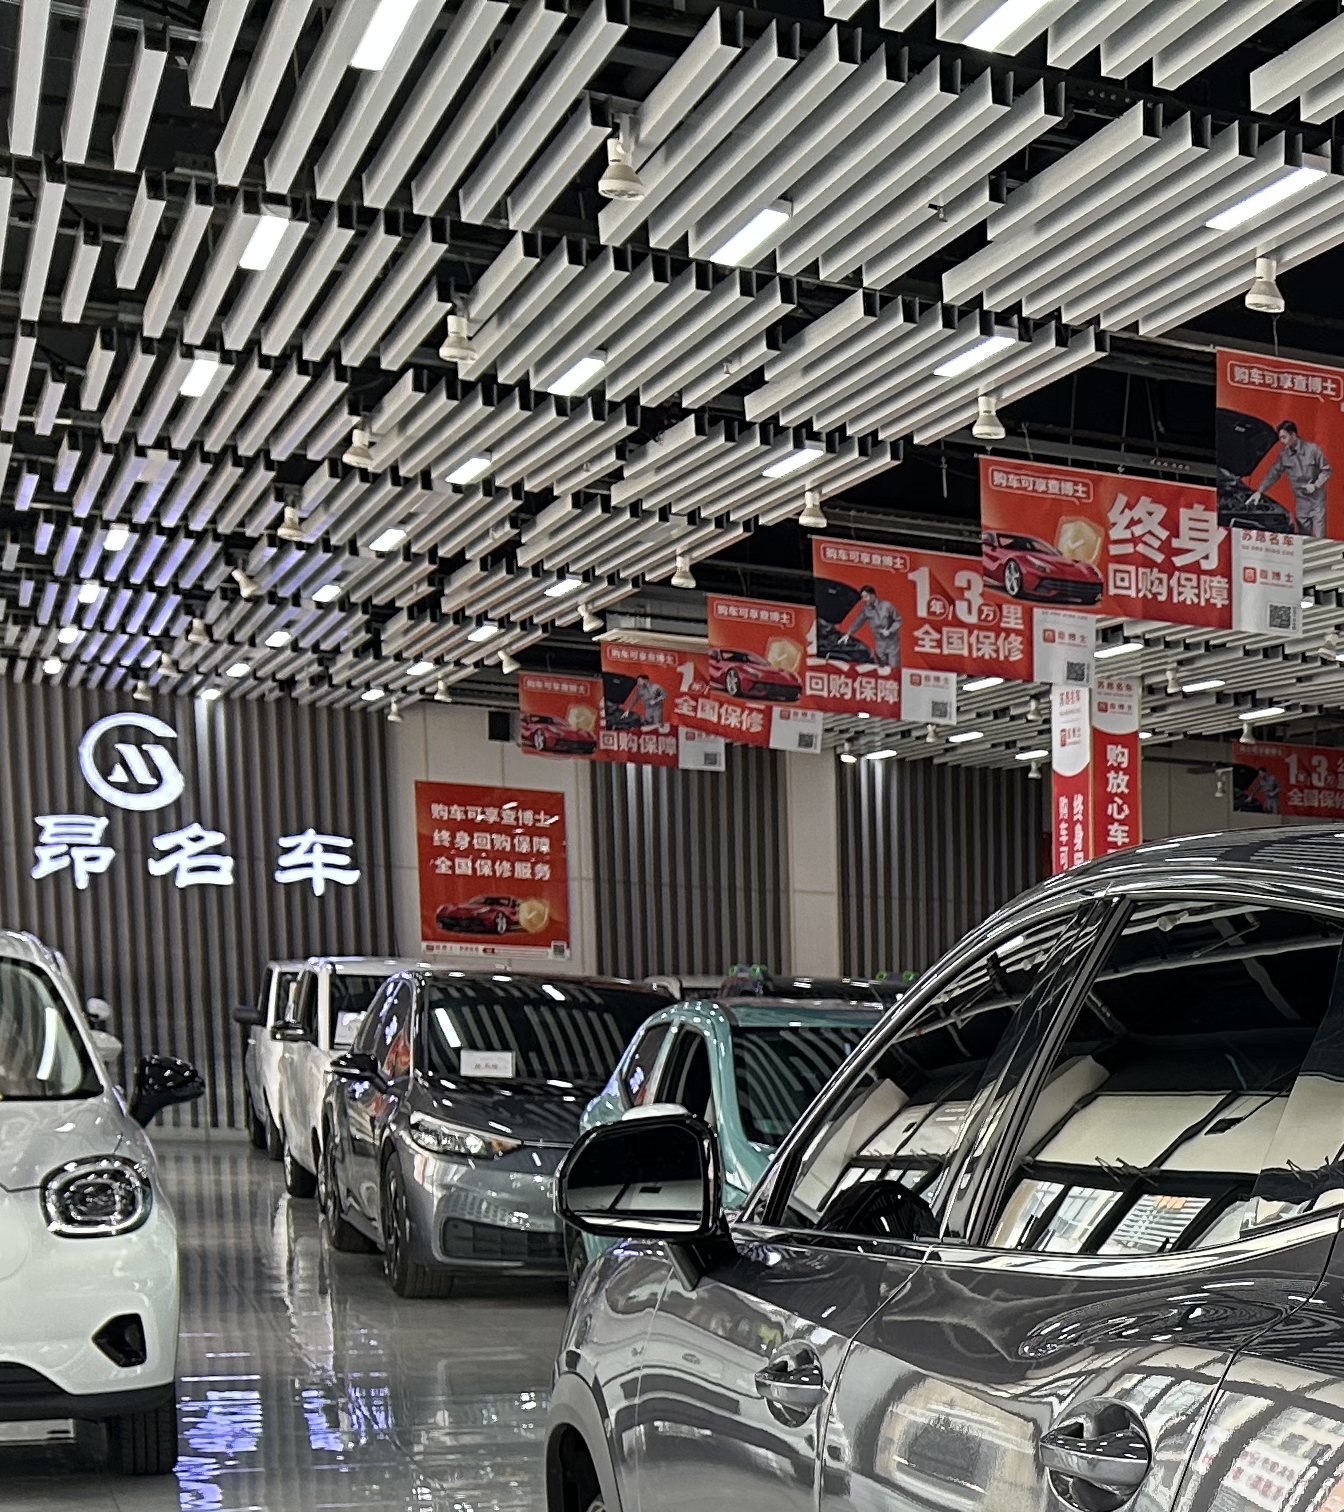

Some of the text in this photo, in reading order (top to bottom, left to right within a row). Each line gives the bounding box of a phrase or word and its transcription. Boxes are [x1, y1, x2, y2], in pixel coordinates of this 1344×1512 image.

[1233, 365, 1337, 397] 购车可享查博士
[993, 470, 1087, 498] 购车可享查博士
[1107, 493, 1227, 570] 终身
[1107, 563, 1230, 609] 回购保障
[914, 624, 1025, 663] 全国保修
[805, 670, 900, 705] 回购保障
[674, 697, 764, 733] 全国保修
[1106, 744, 1130, 855] 购放心车
[30, 814, 361, 897] 昂名车
[432, 828, 551, 854] 终身回购保障
[434, 856, 552, 881] 全国保修服务
